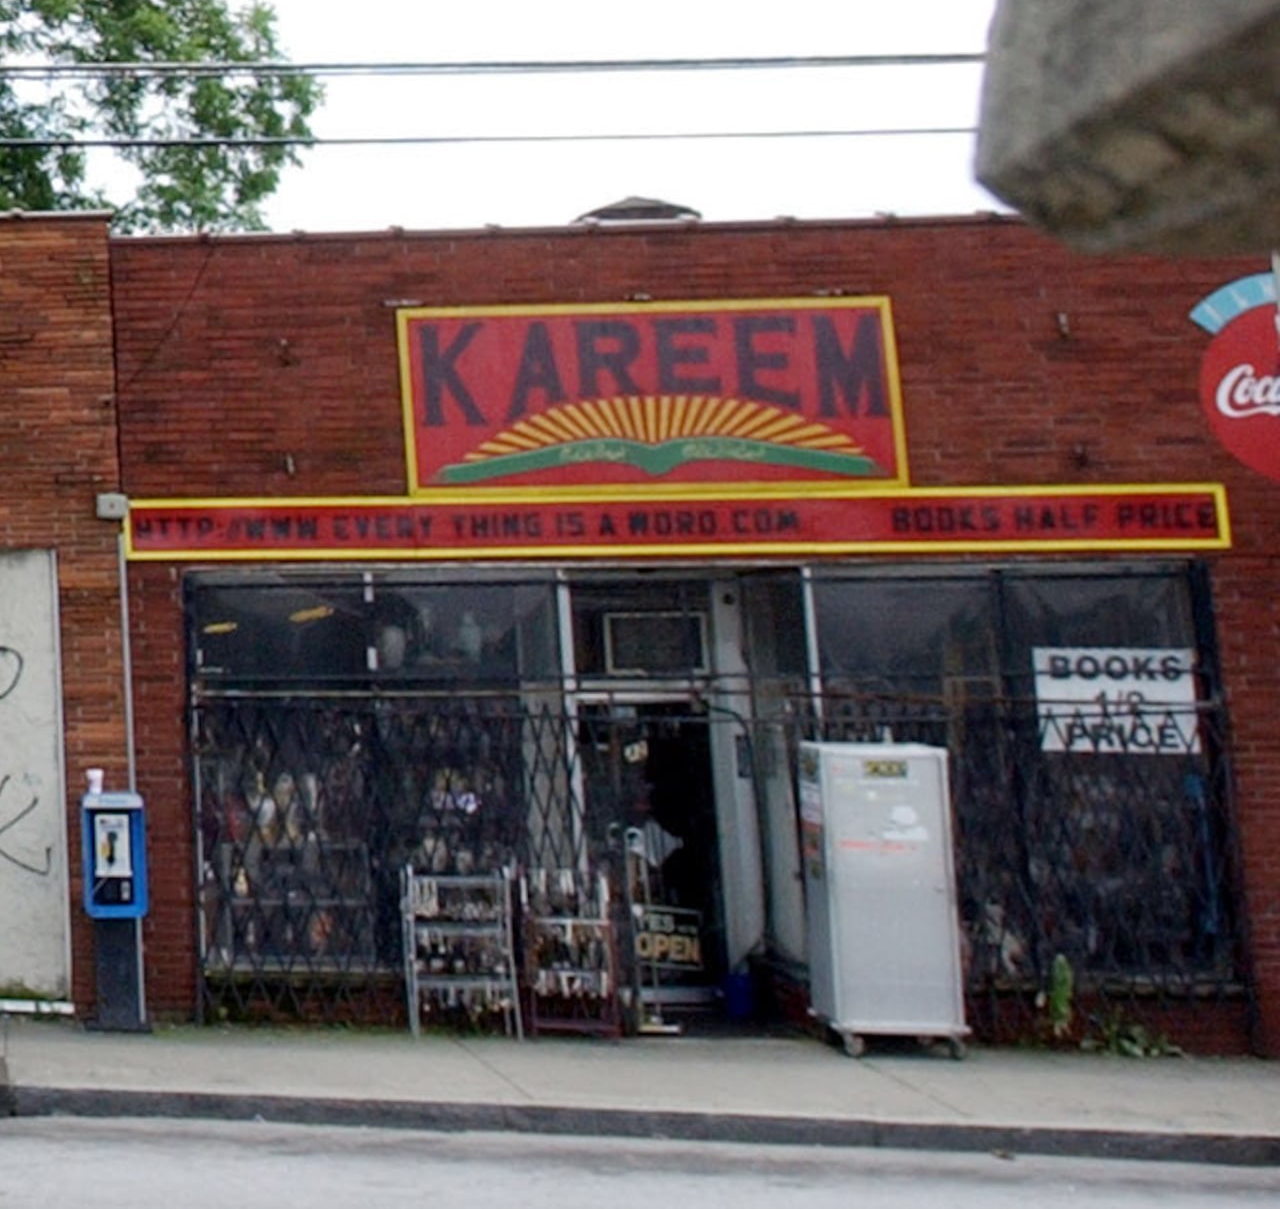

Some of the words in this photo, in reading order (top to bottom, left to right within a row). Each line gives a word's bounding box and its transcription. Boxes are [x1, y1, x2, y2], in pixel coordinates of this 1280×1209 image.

[417, 312, 892, 429] KAREEM
[332, 514, 434, 540] EVERY
[450, 513, 542, 538] THING
[556, 512, 586, 537] IS
[599, 512, 617, 536] A
[892, 505, 1000, 533] BOOKS
[1014, 504, 1098, 532] HALF
[1118, 501, 1216, 530] PRICE
[1049, 654, 1182, 682] BOOKS
[1066, 721, 1180, 749] PRICE
[634, 933, 700, 963] OPEN
